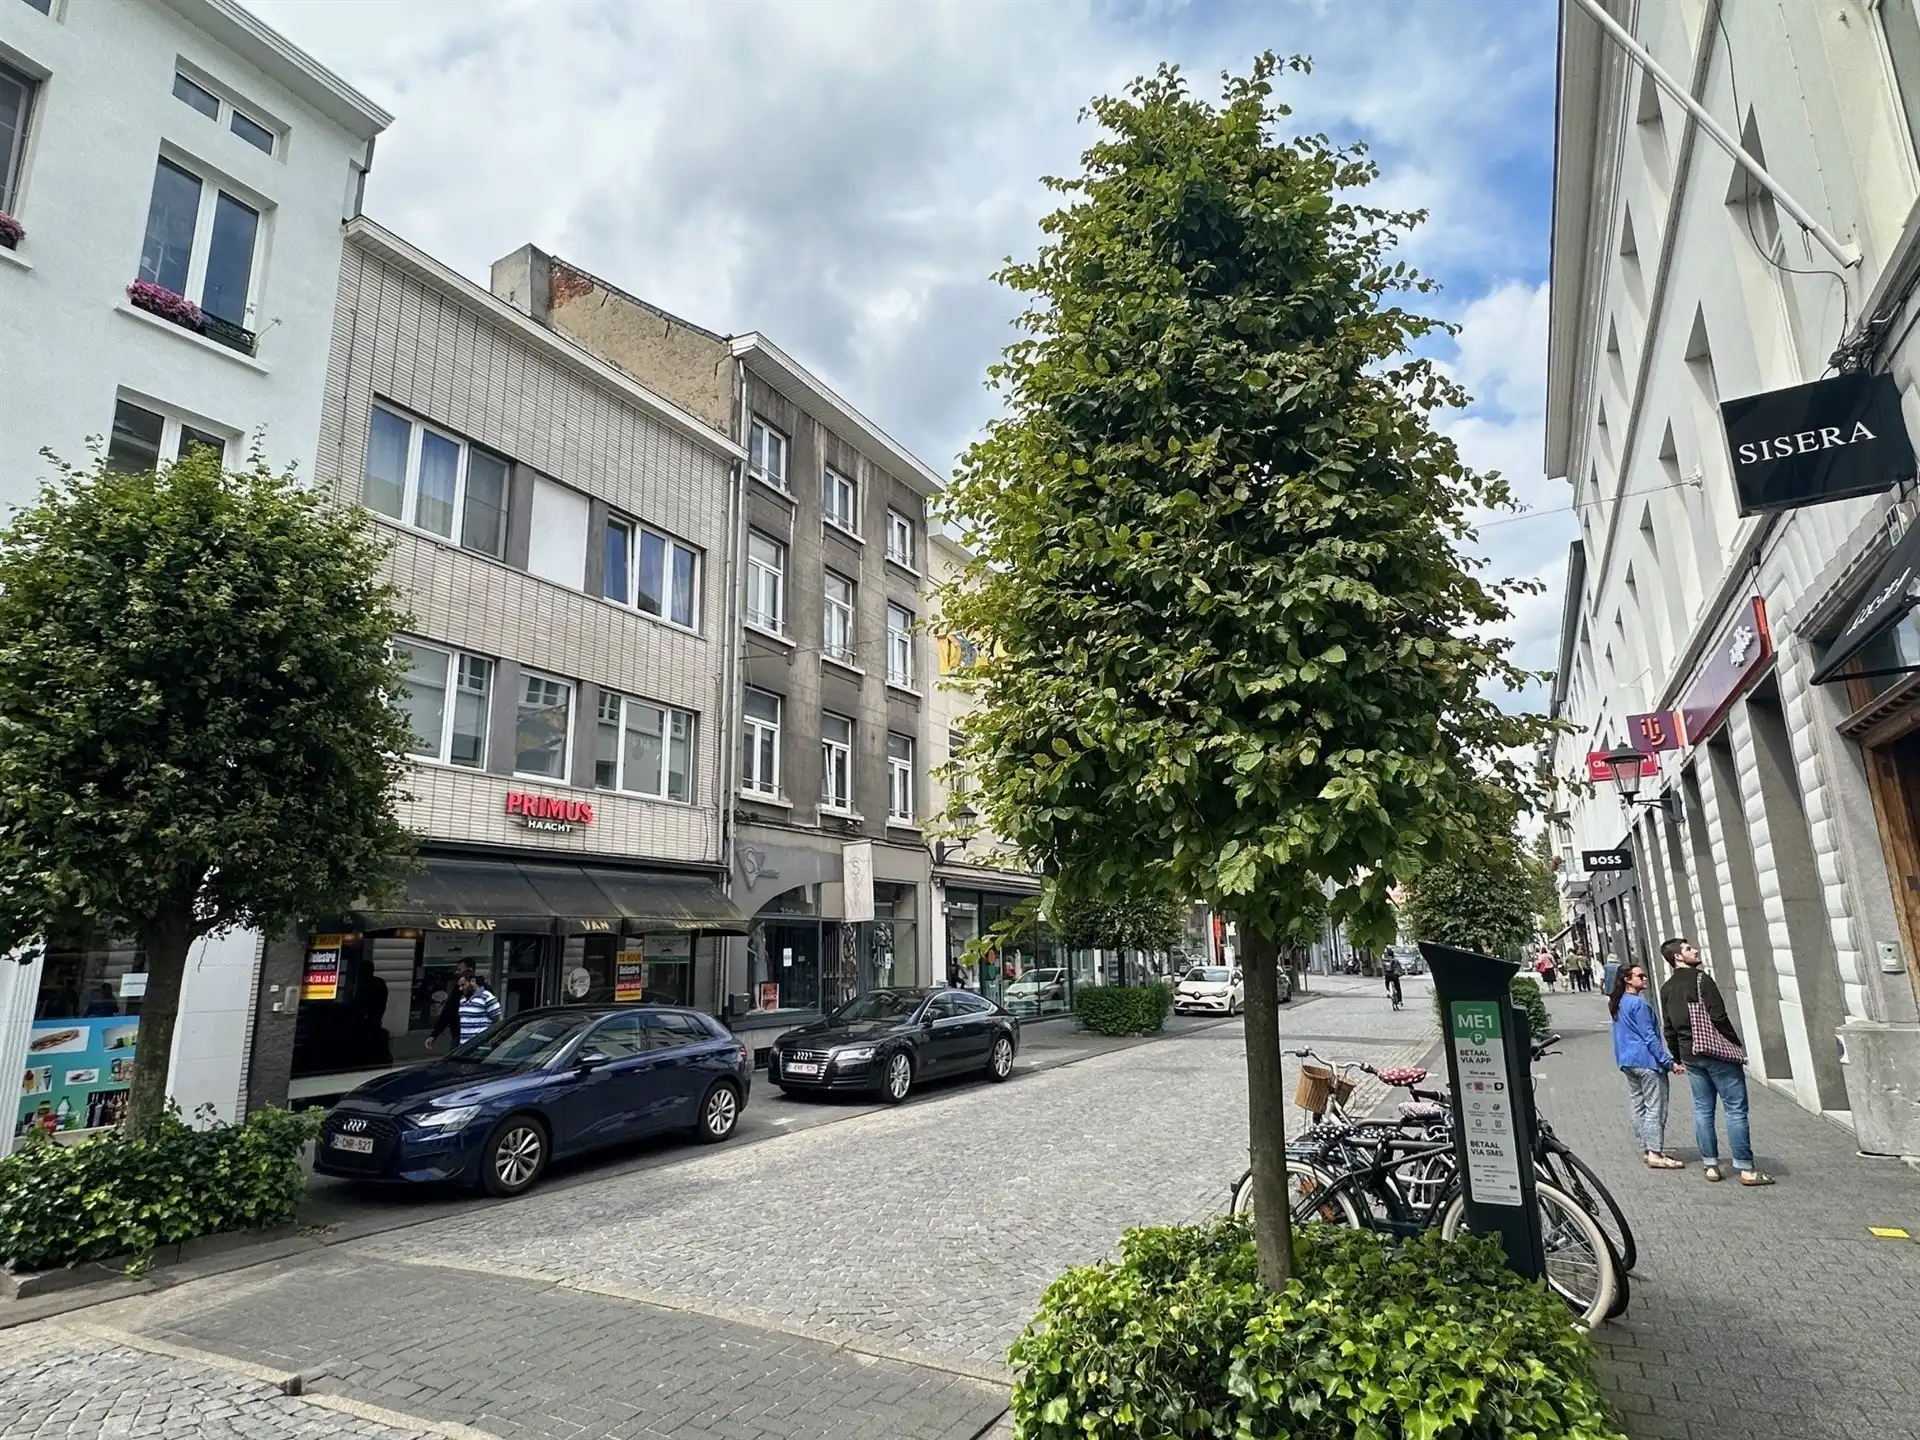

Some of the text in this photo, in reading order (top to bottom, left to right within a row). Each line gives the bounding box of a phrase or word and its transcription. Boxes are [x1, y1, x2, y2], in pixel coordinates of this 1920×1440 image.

[1738, 420, 1877, 465] SISERA
[505, 791, 593, 824] PRIMUS
[528, 820, 573, 832] HAACHT
[1589, 855, 1622, 866] BOSS
[437, 918, 497, 931] GRAAF
[580, 920, 609, 931] VAN
[1457, 1014, 1493, 1029] ME1
[1474, 1033, 1483, 1043] P
[1460, 1049, 1489, 1057] BETAAL
[1470, 1140, 1500, 1149] BETAAL
[1470, 1148, 1504, 1157] VIA SMS
